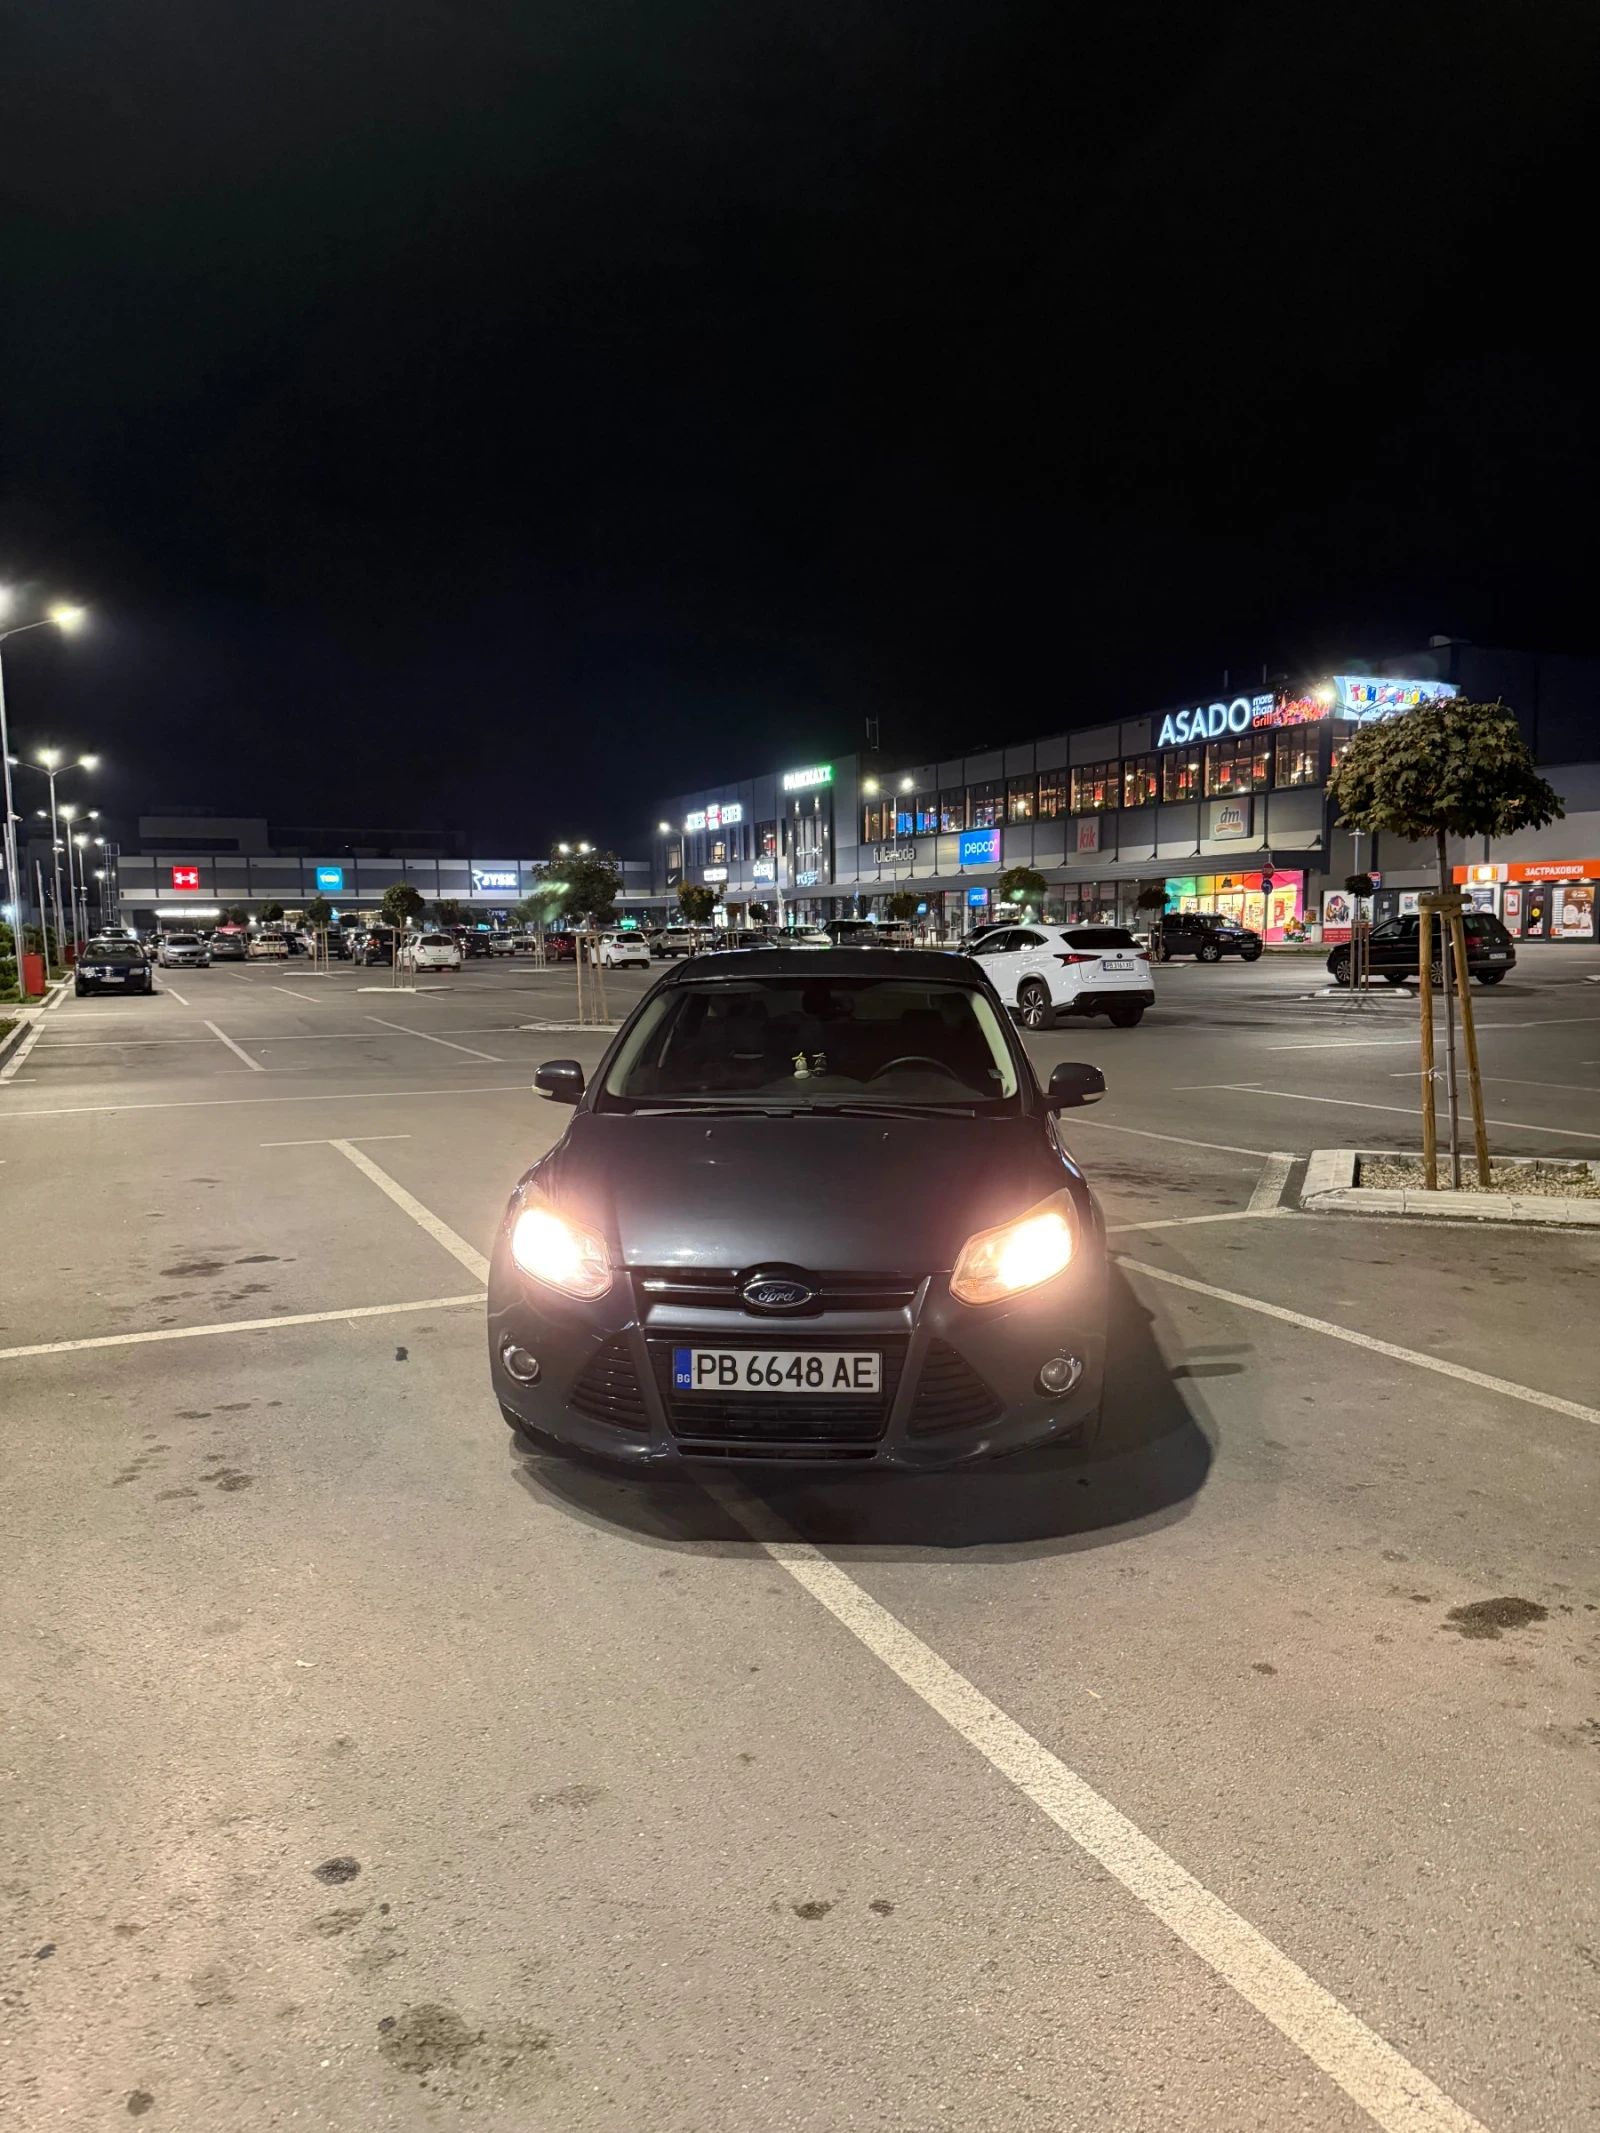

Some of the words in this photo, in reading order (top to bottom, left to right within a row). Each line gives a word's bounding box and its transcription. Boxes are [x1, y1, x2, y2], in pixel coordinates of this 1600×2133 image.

[1252, 693, 1274, 706] more
[1252, 704, 1274, 716] than
[1157, 697, 1250, 748] ASADO
[1252, 715, 1273, 728] Grill
[1220, 807, 1240, 824] dm
[1525, 865, 1584, 876] ЗАСТРАХОВКИ
[482, 873, 517, 886] JYSK
[758, 1285, 795, 1302] Ford
[676, 1374, 691, 1384] BG
[697, 1355, 738, 1386] PB
[746, 1356, 823, 1388] 6648
[832, 1357, 874, 1388] AE
